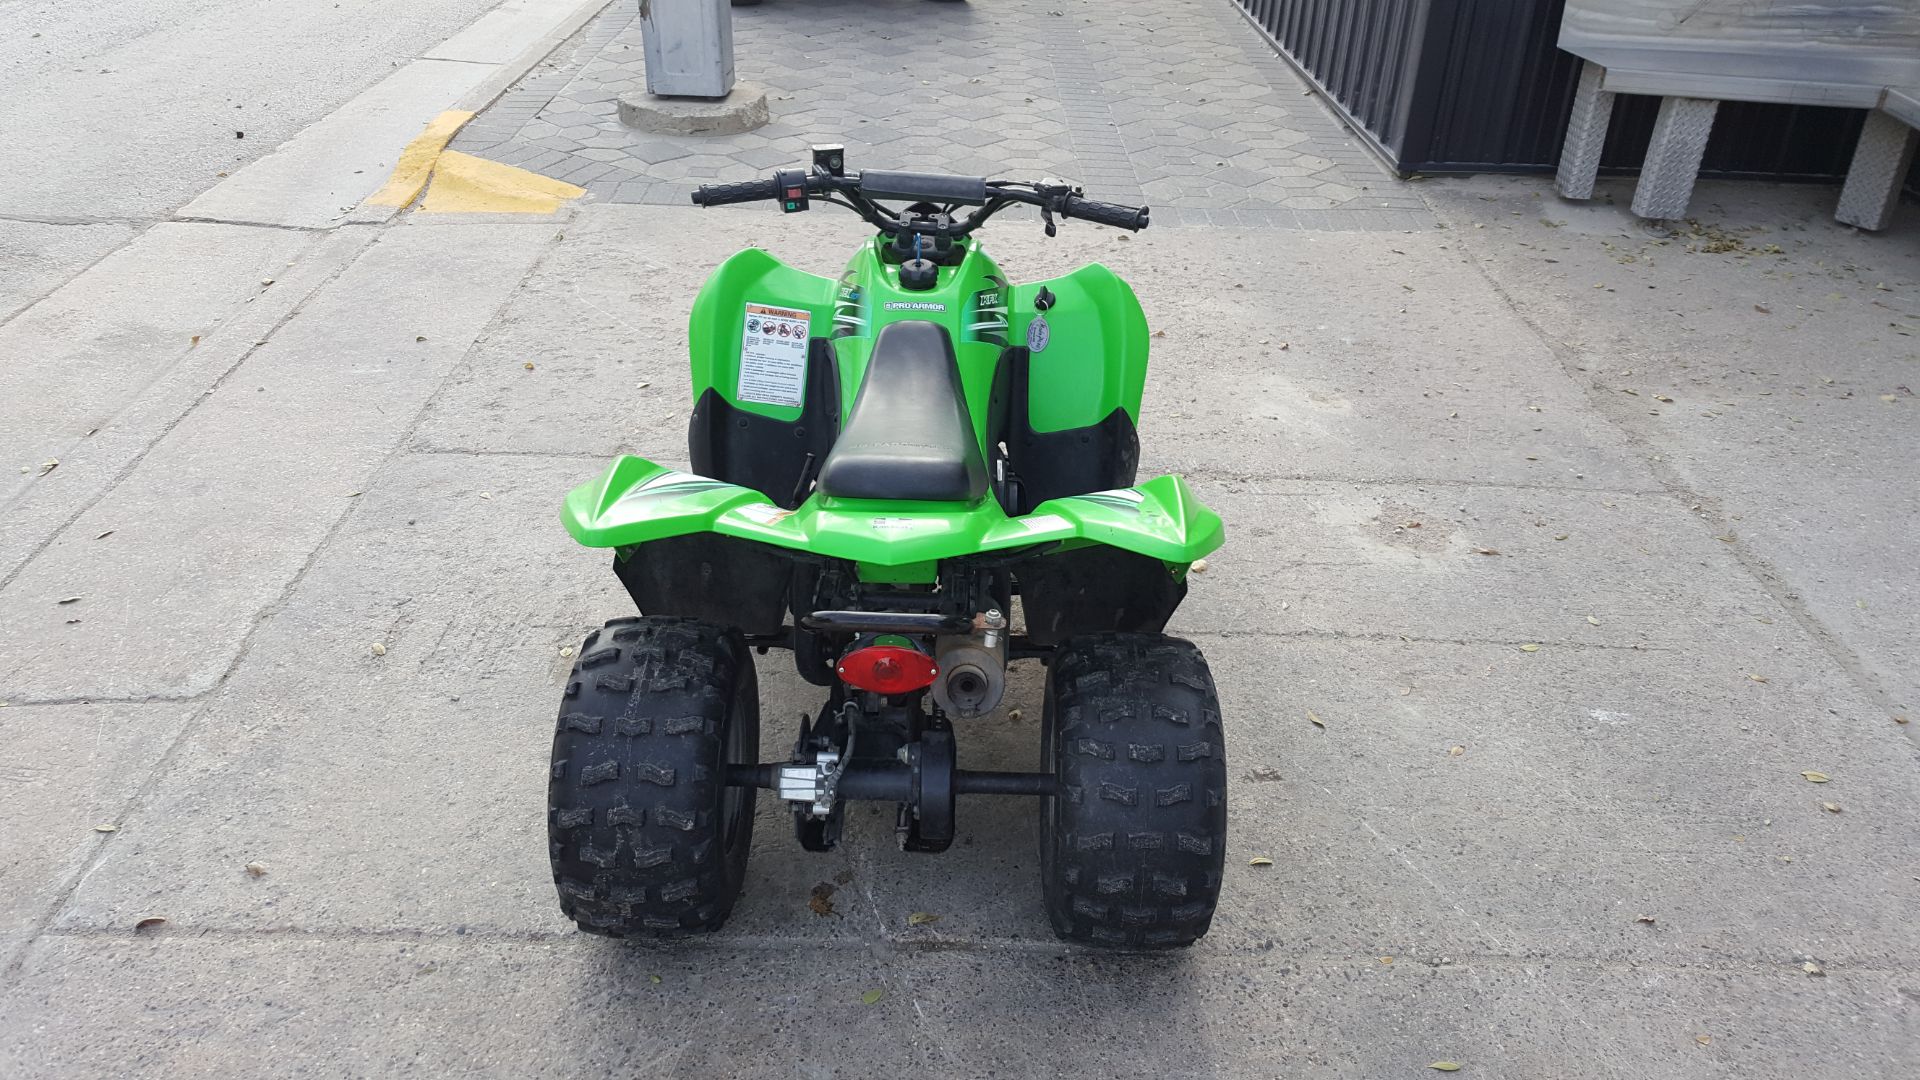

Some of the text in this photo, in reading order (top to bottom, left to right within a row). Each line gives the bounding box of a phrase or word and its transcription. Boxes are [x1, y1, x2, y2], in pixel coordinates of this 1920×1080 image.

[893, 302, 945, 311] PRO ARMOR
[768, 308, 797, 318] WARNING
